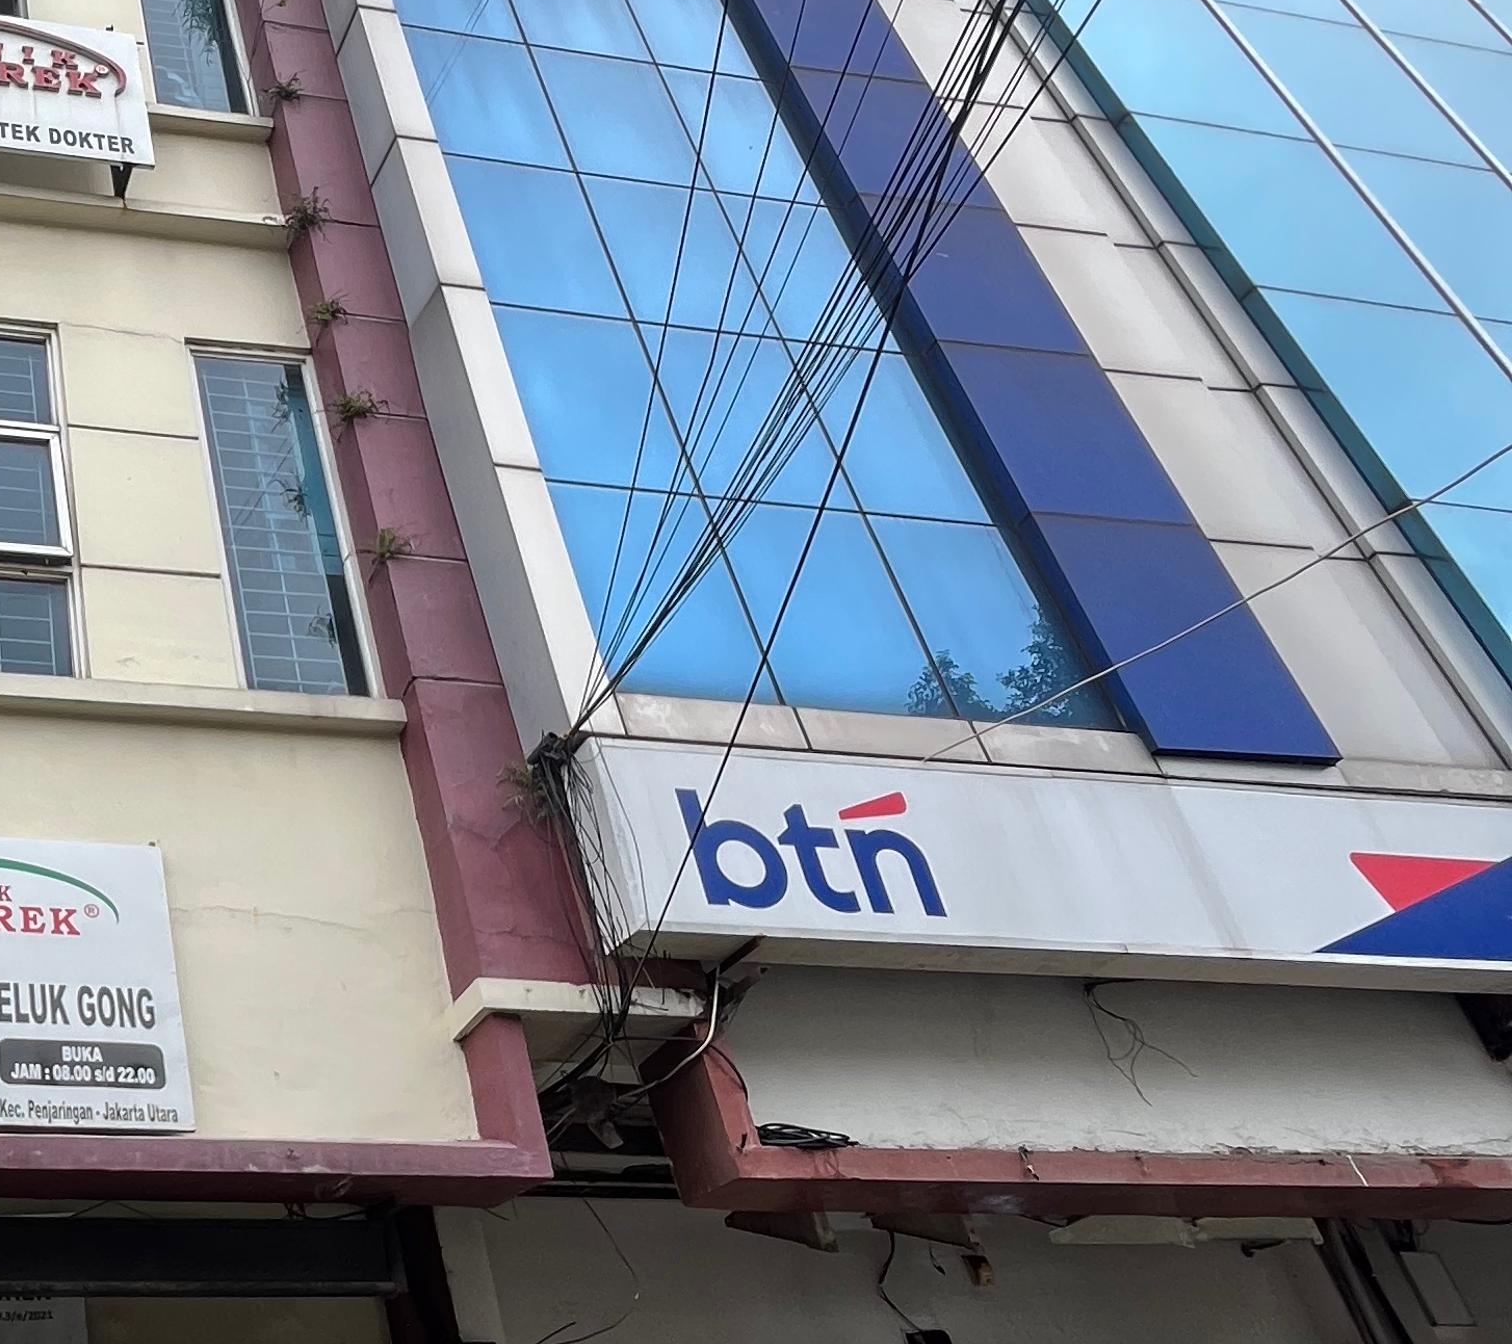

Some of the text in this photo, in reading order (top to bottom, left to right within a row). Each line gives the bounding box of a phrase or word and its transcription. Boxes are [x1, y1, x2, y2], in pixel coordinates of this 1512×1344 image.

[49, 128, 135, 155] DOKTER
[675, 788, 948, 919] btn
[77, 985, 156, 1030] GONG
[62, 1046, 103, 1063] BUKA
[10, 1063, 41, 1080] JAM
[52, 1065, 91, 1082] 08.00
[94, 1066, 115, 1083] s/d
[117, 1067, 155, 1084] 22.00
[0, 1099, 25, 1118] Kec.
[28, 1100, 93, 1125] Penjaringan
[102, 1102, 145, 1122] Jakarta
[147, 1104, 178, 1123] Utara
